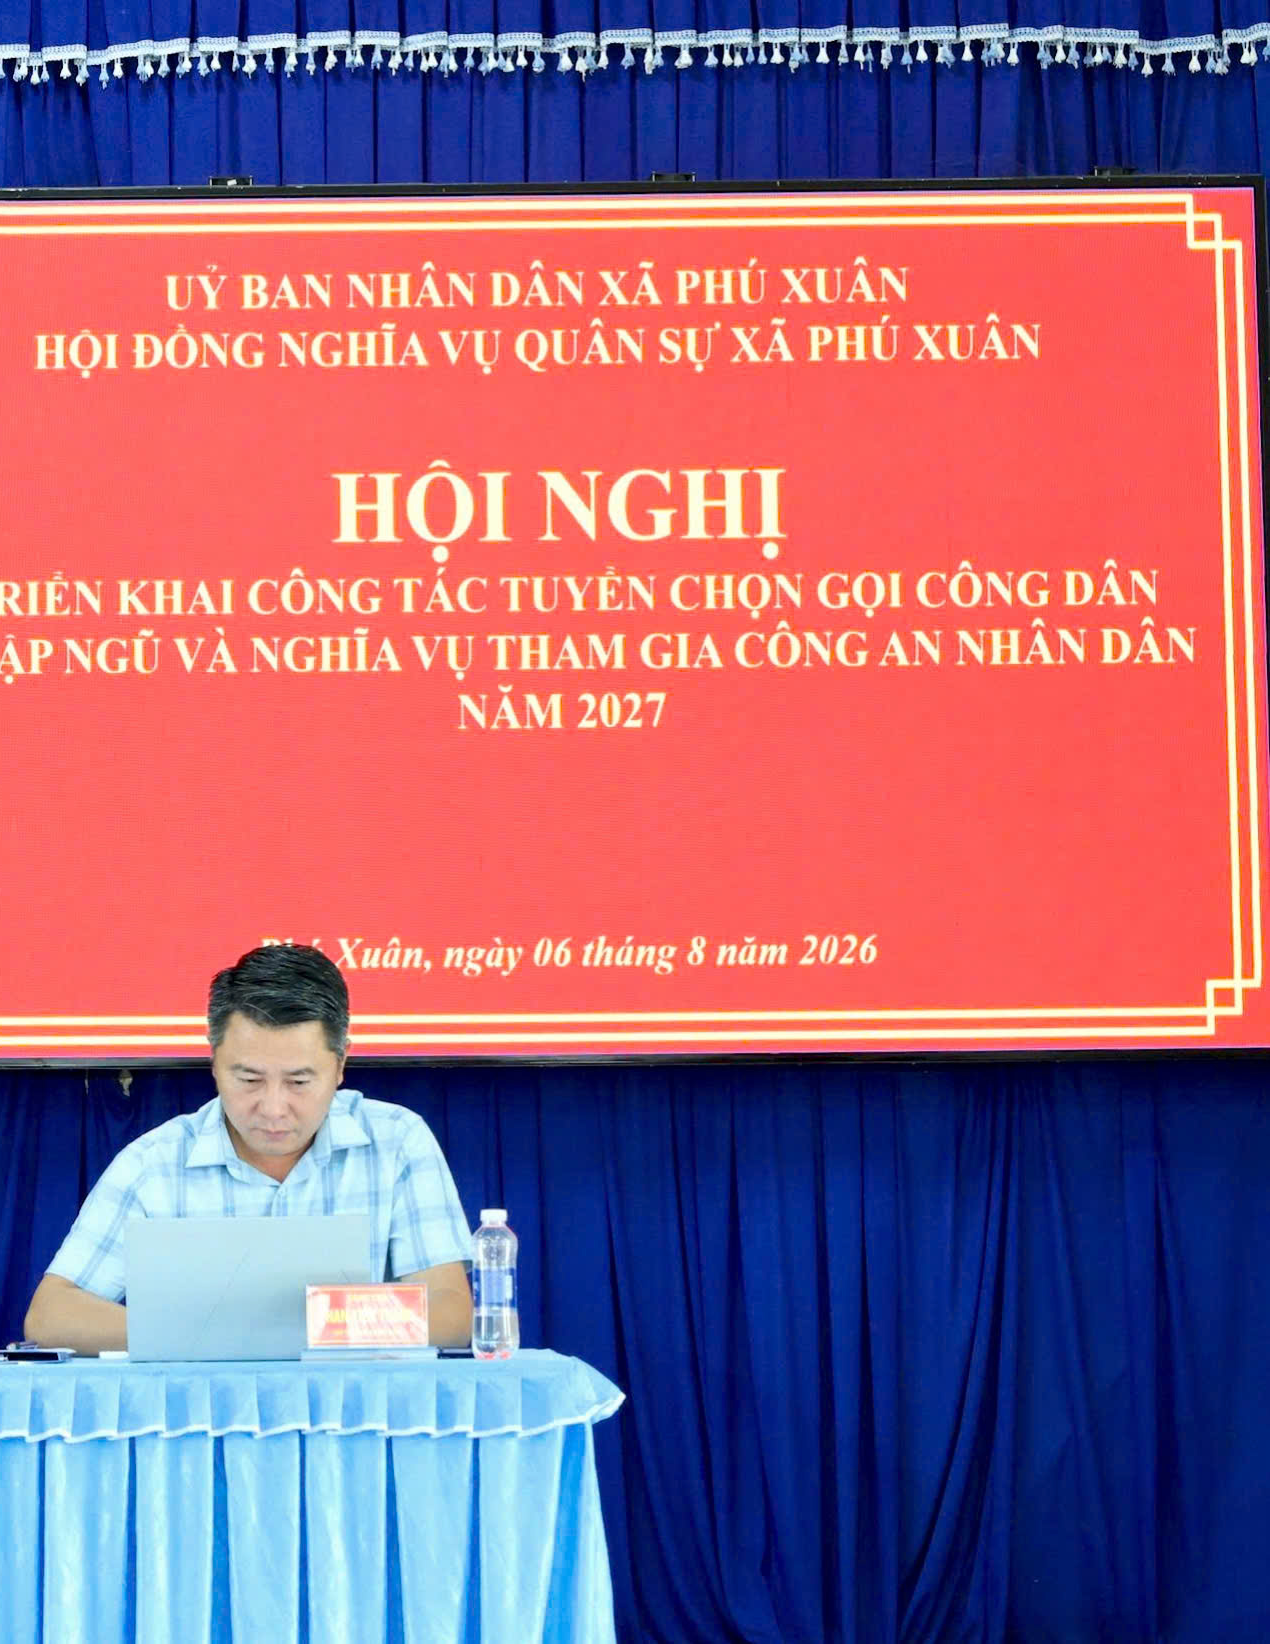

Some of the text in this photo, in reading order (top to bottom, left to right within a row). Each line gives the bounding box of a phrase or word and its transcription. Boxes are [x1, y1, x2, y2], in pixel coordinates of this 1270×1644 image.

[164, 255, 909, 312] UỶ BAN NHÂN DÂN XÃ PHÚ XUÂN
[33, 311, 1041, 380] HỘI ĐỒNG NGHĨA VỤ QUÂN SỰ XÃ PHÚ XUÂN
[330, 458, 787, 564] HỘI NGHỊ
[116, 578, 235, 617] KHAI
[246, 566, 383, 616] CÔNG
[392, 565, 488, 614] TÁC
[669, 572, 804, 621] CHỌN
[816, 571, 903, 619] GỌI
[915, 559, 1051, 609] CÔNG
[1063, 558, 1159, 607] DÂN
[62, 627, 163, 675] NGŨ
[172, 626, 239, 675] VÀ
[249, 626, 403, 673] NGHĨA
[410, 634, 475, 681] VỤ
[486, 632, 627, 672] THAM
[639, 632, 724, 670] GIA
[733, 619, 870, 669] CÔNG
[878, 629, 943, 667] AN
[955, 616, 1087, 666] NHÂN
[1100, 615, 1197, 665] DÂN
[457, 683, 667, 731] NĂM 2027
[334, 935, 433, 974] Xuân,
[442, 936, 525, 977] ngày
[532, 936, 573, 968] 06
[581, 934, 678, 976] tháng
[686, 935, 707, 966] 8
[715, 935, 789, 967] năm
[798, 933, 878, 966] 2026
